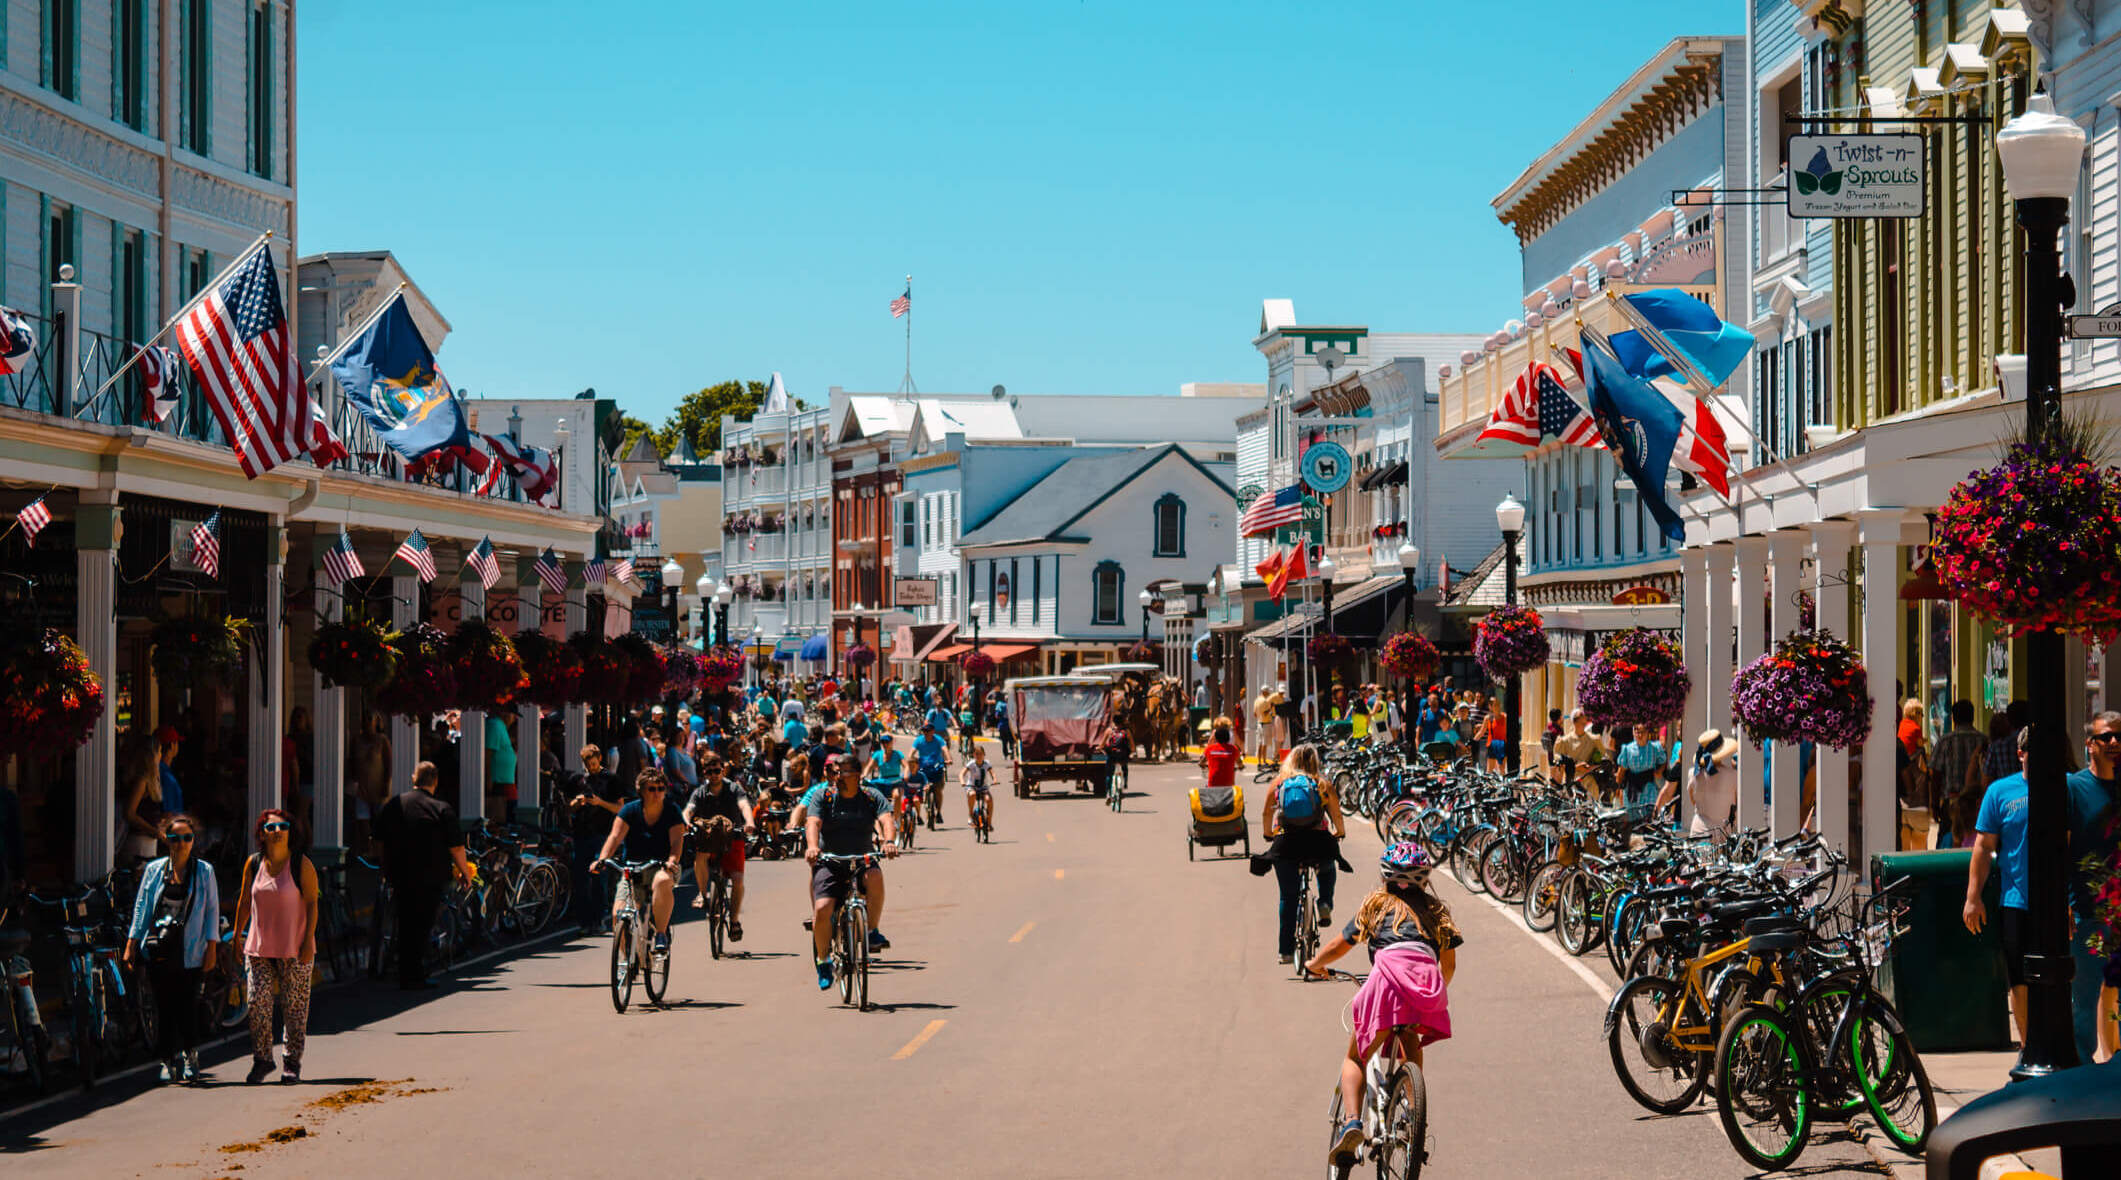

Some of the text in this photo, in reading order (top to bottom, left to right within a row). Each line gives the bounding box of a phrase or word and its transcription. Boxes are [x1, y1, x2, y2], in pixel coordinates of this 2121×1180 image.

[1846, 164, 1919, 188] Sprouts
[1846, 190, 1890, 200] Premium
[2099, 321, 2121, 331] FO
